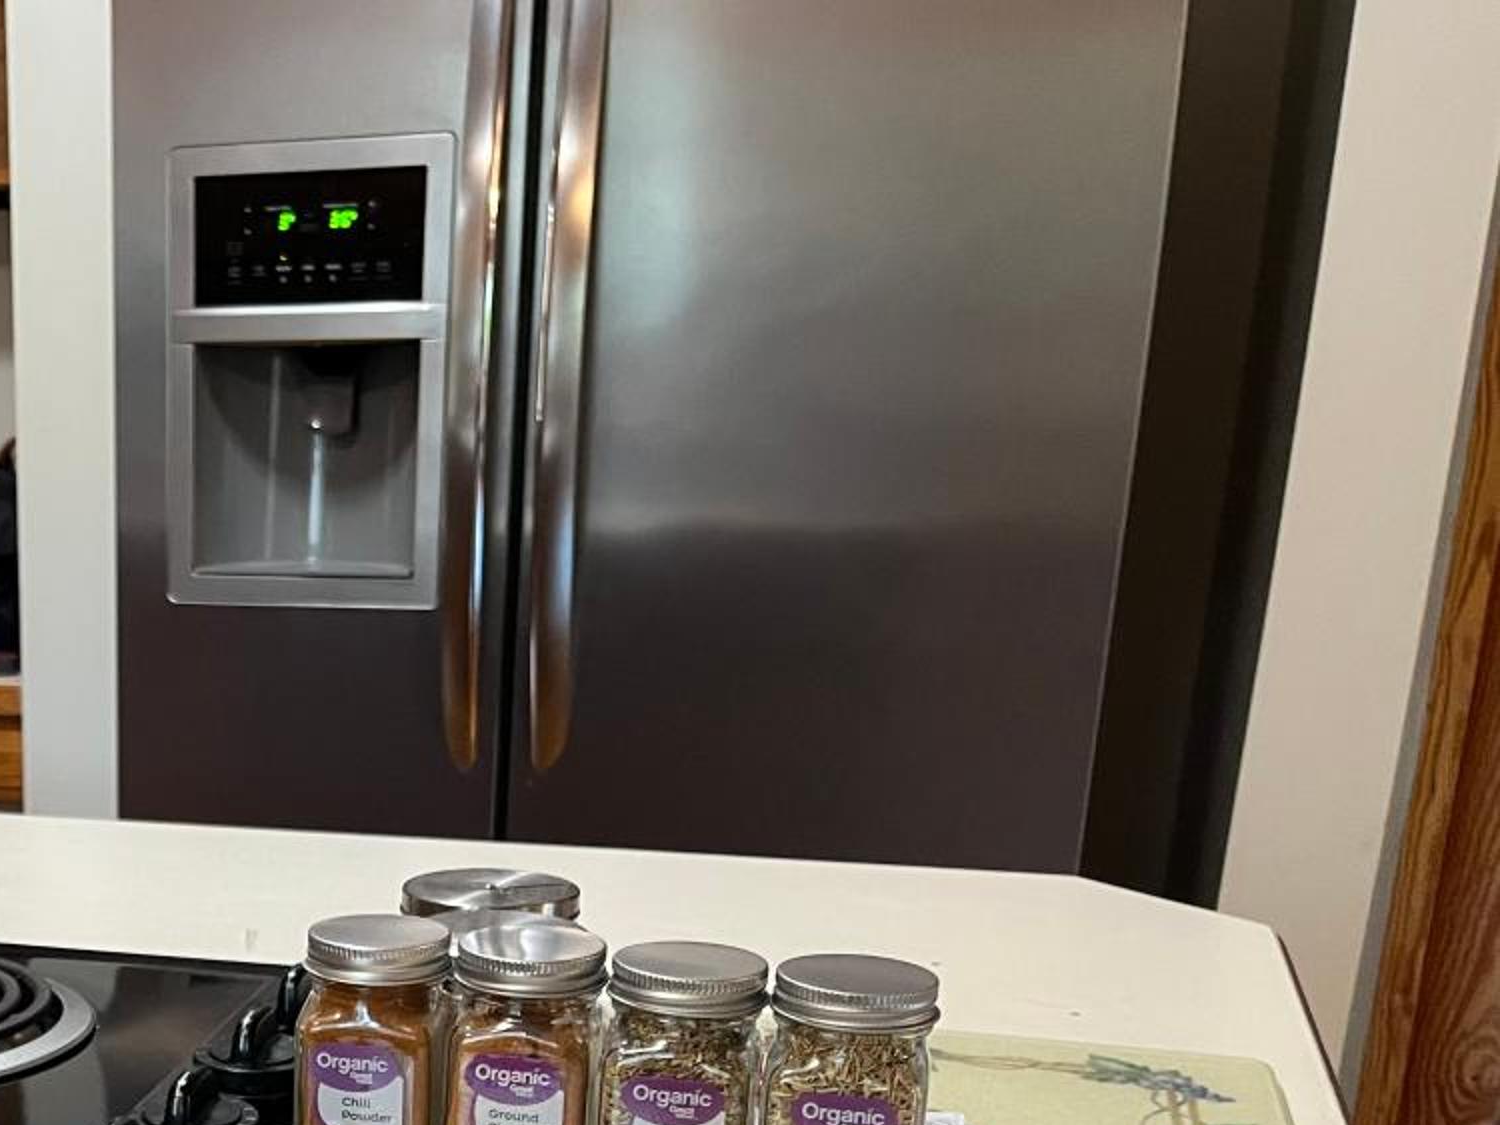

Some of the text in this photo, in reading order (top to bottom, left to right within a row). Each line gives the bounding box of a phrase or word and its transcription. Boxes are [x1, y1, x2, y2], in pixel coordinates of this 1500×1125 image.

[317, 1052, 389, 1075] Organic
[475, 1063, 551, 1087] Organic
[342, 1097, 371, 1108] Chili
[633, 1084, 713, 1107] Organic
[488, 1108, 539, 1123] Ground
